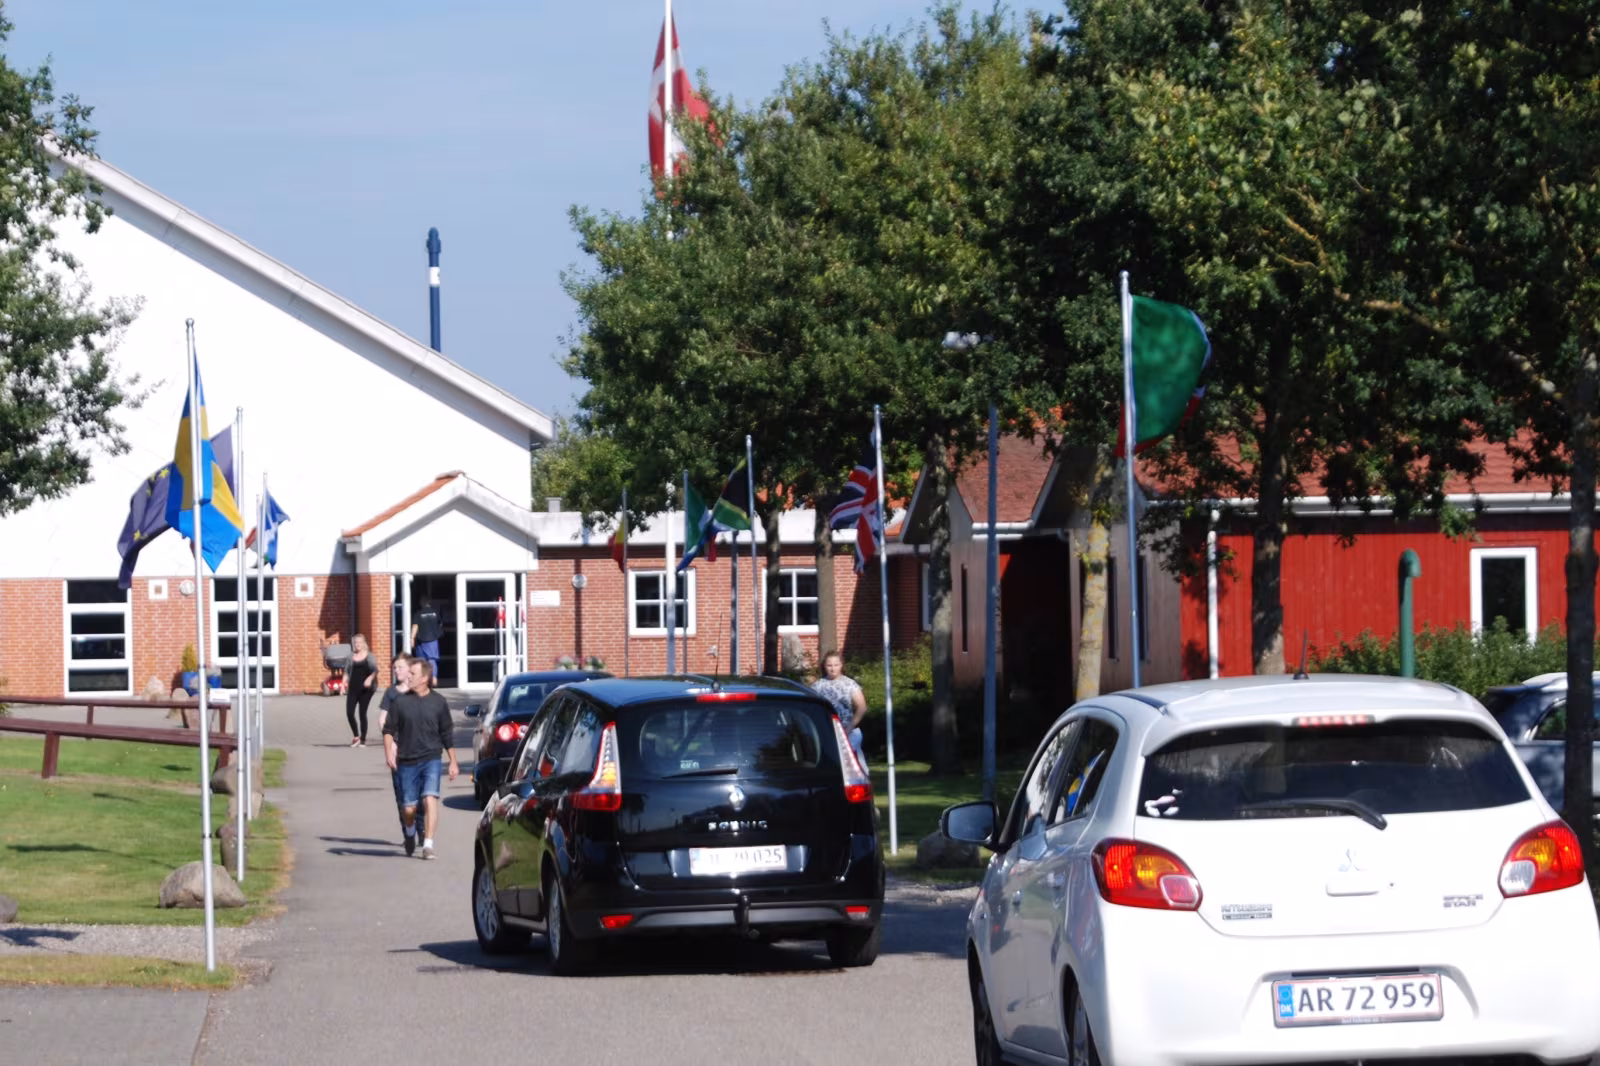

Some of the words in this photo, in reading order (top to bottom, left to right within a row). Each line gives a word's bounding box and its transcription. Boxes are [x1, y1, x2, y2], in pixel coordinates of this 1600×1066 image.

[1298, 987, 1334, 1012] AR
[1341, 985, 1376, 1010] 72
[1383, 982, 1435, 1009] 959
[1280, 1004, 1293, 1013] DK
